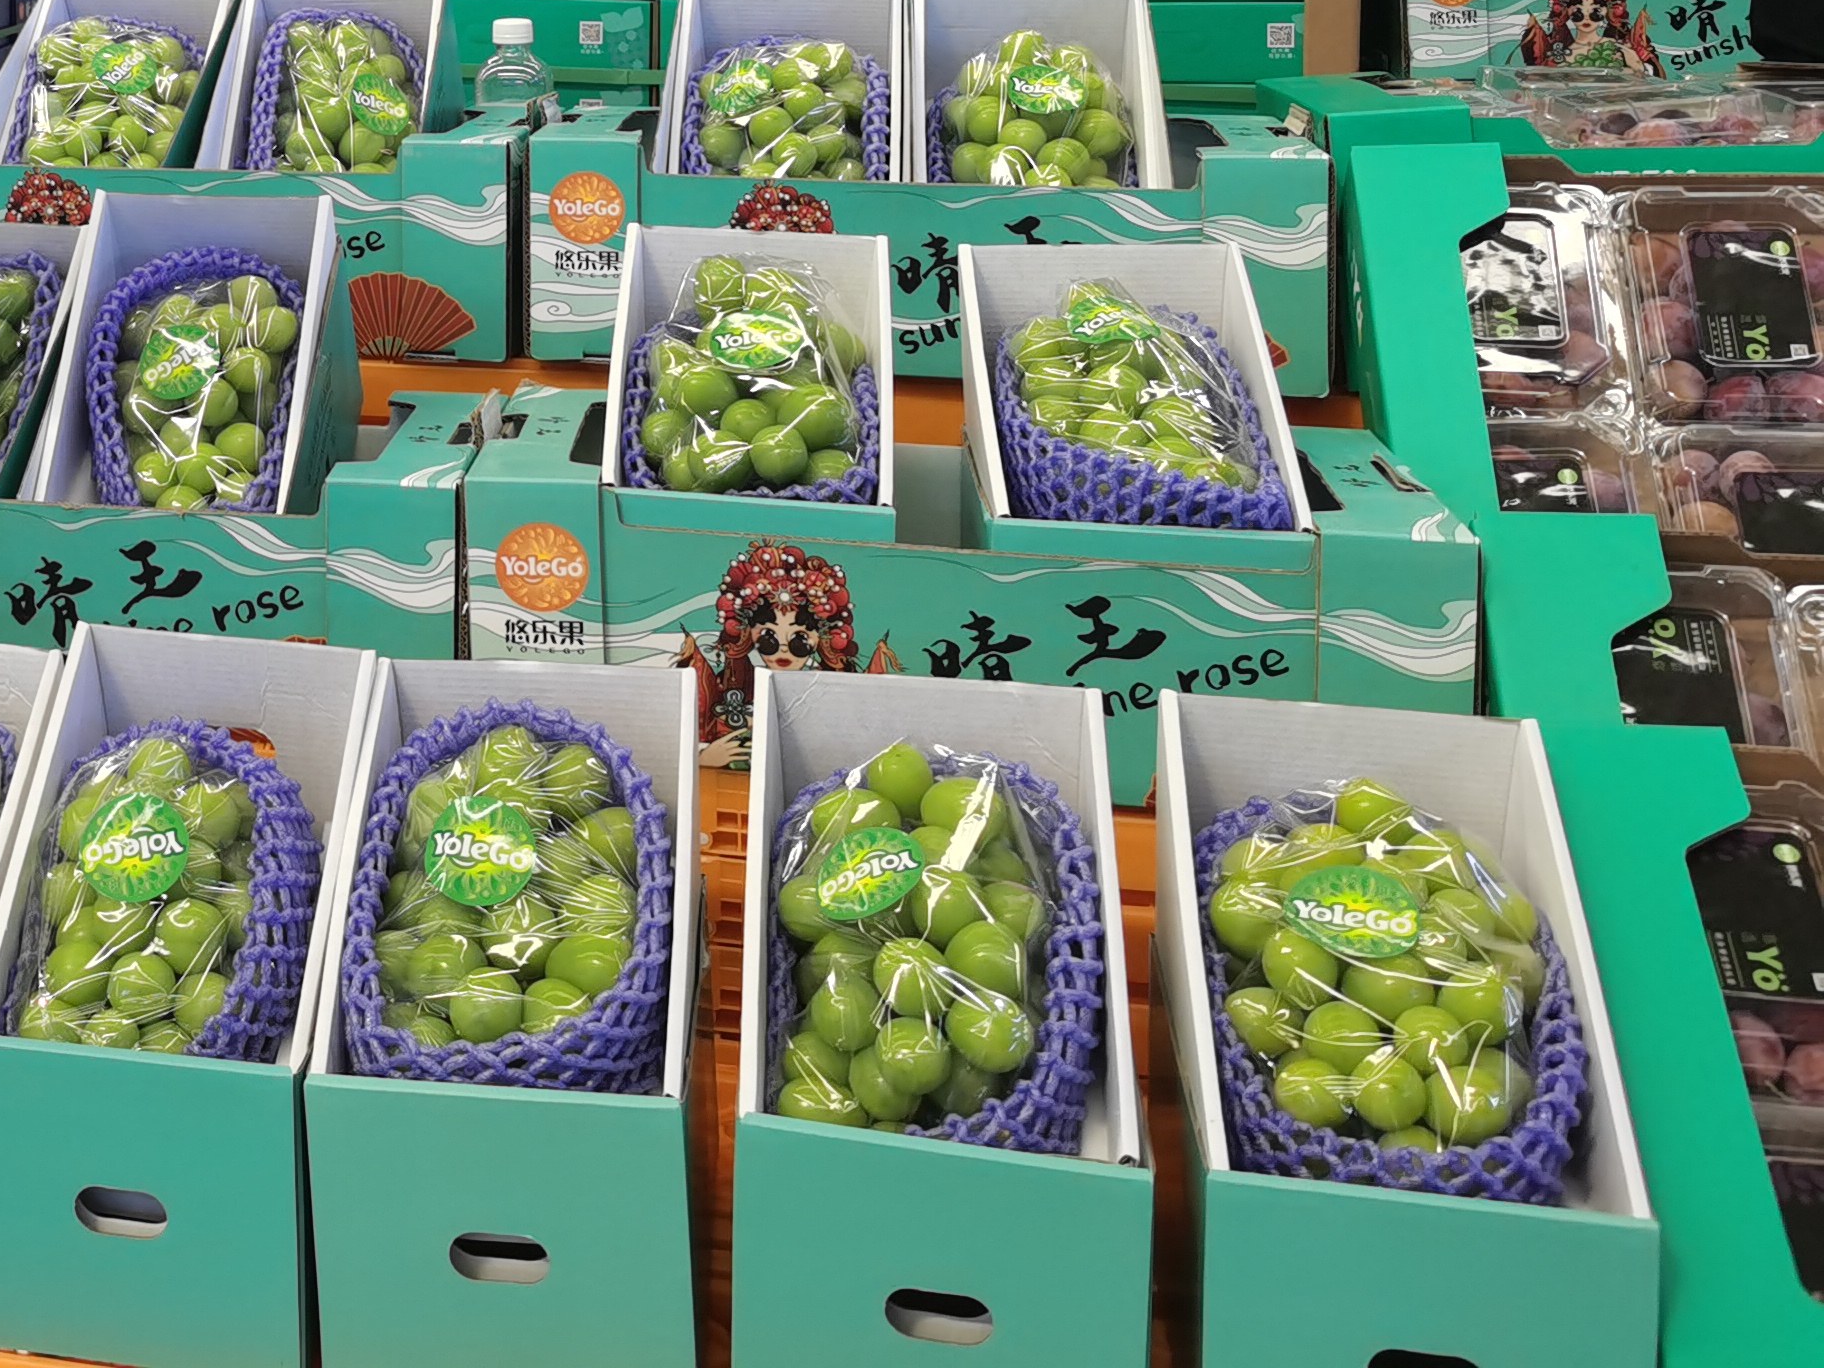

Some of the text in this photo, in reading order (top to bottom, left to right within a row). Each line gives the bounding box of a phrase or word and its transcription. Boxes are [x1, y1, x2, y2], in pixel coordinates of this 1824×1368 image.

[1670, 26, 1752, 71] sunsh
[555, 249, 620, 272] 悠乐果
[212, 582, 303, 629] rose
[503, 617, 585, 645] 悠乐果
[1179, 646, 1289, 690] rose
[432, 834, 534, 870] YoleGo
[1292, 897, 1417, 938] YoleGo
